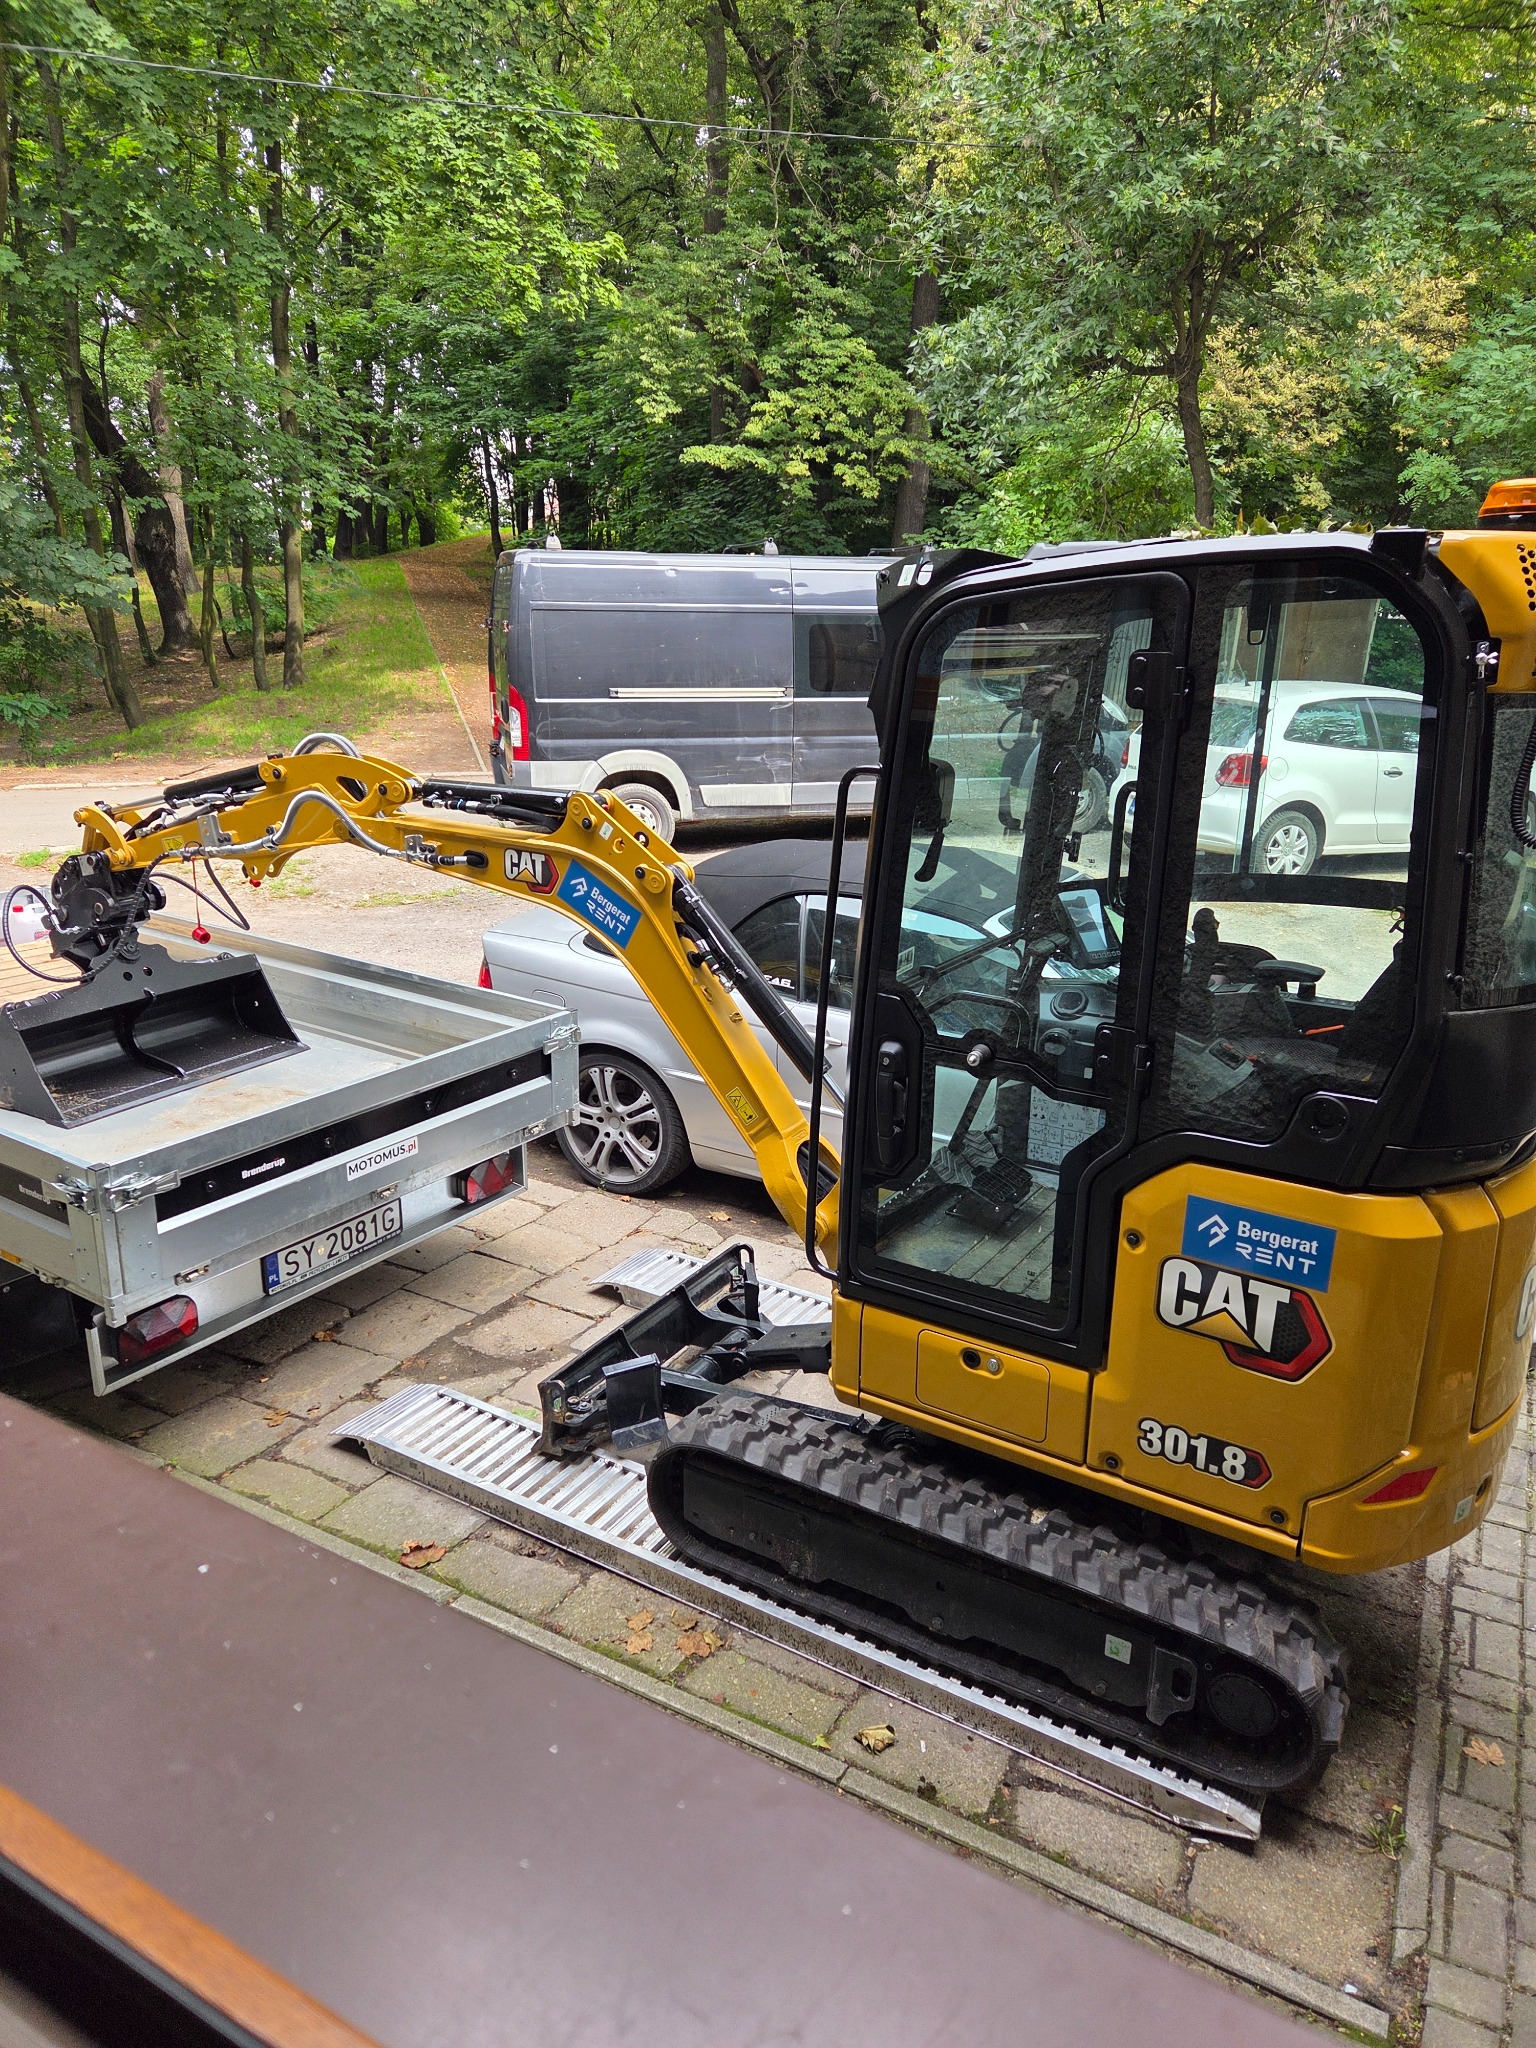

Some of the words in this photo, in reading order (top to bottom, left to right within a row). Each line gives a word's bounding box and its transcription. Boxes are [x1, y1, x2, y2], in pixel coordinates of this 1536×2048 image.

[505, 849, 545, 884] CAT
[586, 899, 626, 935] RENT
[590, 887, 631, 925] Bergerat
[348, 1140, 417, 1176] MOTOMUS.pl
[284, 1241, 316, 1276] SY
[326, 1207, 395, 1259] 2081G
[1237, 1220, 1319, 1255] Bergerat
[1235, 1241, 1316, 1275] RENT
[268, 1274, 279, 1283] PL
[1160, 1258, 1291, 1353] CAT
[1139, 1419, 1247, 1481] 301.8
